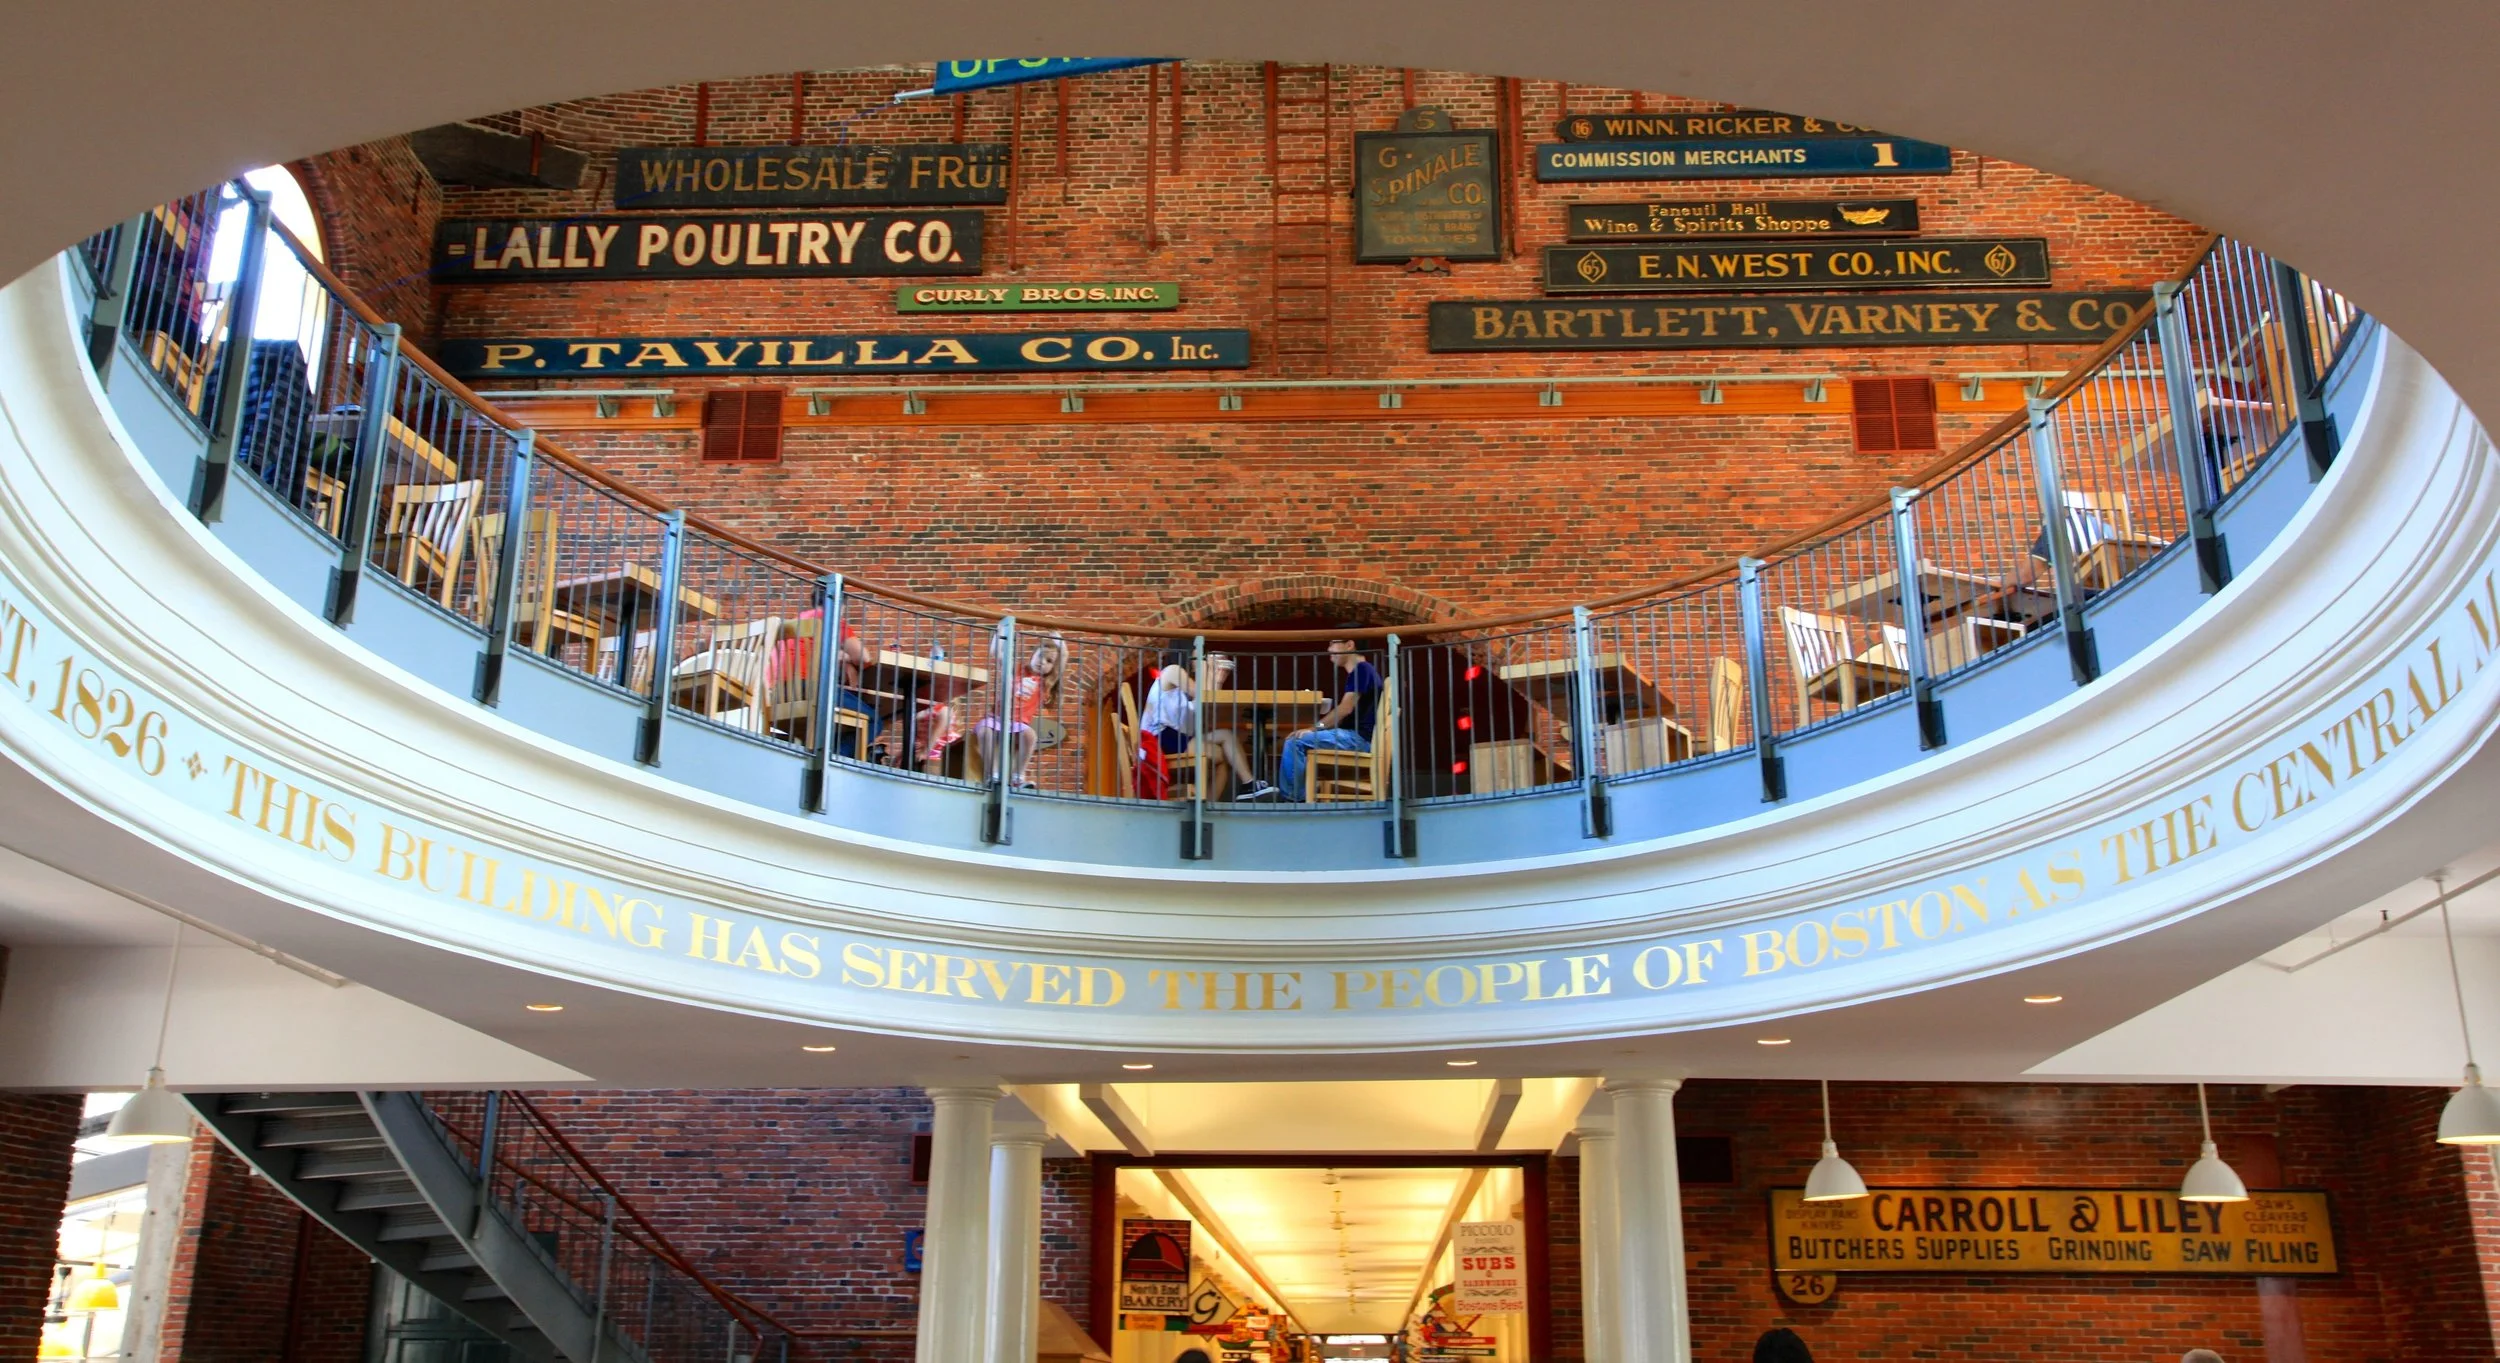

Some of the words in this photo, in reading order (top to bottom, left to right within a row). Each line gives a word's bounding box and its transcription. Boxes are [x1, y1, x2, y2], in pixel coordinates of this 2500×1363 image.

[1414, 111, 1436, 130] 5
[1604, 118, 1679, 137] WINN.
[1687, 116, 1792, 136] RICKER
[1803, 116, 1824, 133] &
[1551, 151, 1675, 168] COMMISSION
[1684, 148, 1807, 166] MERCHANTS
[1872, 142, 1899, 167] 1
[640, 155, 889, 193] WHOLESALE
[1371, 143, 1483, 207] SPINALE
[1649, 204, 1718, 217] Faneuil
[1731, 203, 1769, 216] Hall
[1585, 218, 1639, 233] Wine
[1650, 218, 1663, 233] &
[1675, 217, 1745, 235] Spirits
[1756, 216, 1831, 233] Shoppe
[637, 220, 867, 268] POULTRY
[883, 220, 964, 264] CO.
[1581, 258, 1601, 278] 65
[1990, 252, 2007, 271] 67
[914, 288, 1010, 304] CURLY
[1472, 306, 1780, 340] BARTLETT,
[1785, 303, 2000, 336] VARNEY
[2016, 299, 2057, 332] &
[480, 344, 547, 369] P.
[568, 340, 979, 368] TAVILLA
[1020, 336, 1155, 363] CO.
[1170, 336, 1220, 361] Inc.
[47, 655, 169, 777] 1826
[222, 753, 357, 863] THIS
[373, 821, 669, 951] BUILDING
[685, 911, 822, 979] HAS
[841, 941, 1126, 1009] SERVED
[1148, 968, 1304, 1012] THE
[1330, 953, 1613, 1012] PEOPLE
[1632, 938, 1723, 991] OF
[1739, 876, 1990, 978] BOSTON
[2007, 849, 2086, 919] AS
[2101, 793, 2219, 886] THE
[2232, 635, 2464, 833] CENTRAL
[1872, 1193, 2051, 1233] CARROLL
[2069, 1195, 2099, 1233] &
[2115, 1195, 2225, 1235] LILEY
[2255, 1199, 2296, 1210] SAWS
[2243, 1210, 2309, 1222] CLEAVERS
[1460, 1224, 1516, 1237] PICCOLO
[2250, 1222, 2307, 1234] CUTLERY
[1788, 1236, 1905, 1261] BUTCHERS
[1916, 1236, 2021, 1261] SUPPLIES
[2048, 1236, 2153, 1262] GRINDING
[2182, 1238, 2232, 1263] SAW
[2245, 1238, 2320, 1264] FILING
[1462, 1256, 1517, 1271] SUBS
[1130, 1283, 1159, 1295] North
[1160, 1283, 1181, 1295] End
[1791, 1273, 1826, 1297] 26
[1122, 1295, 1187, 1308] BAKERY
[1500, 1298, 1524, 1311] Best
